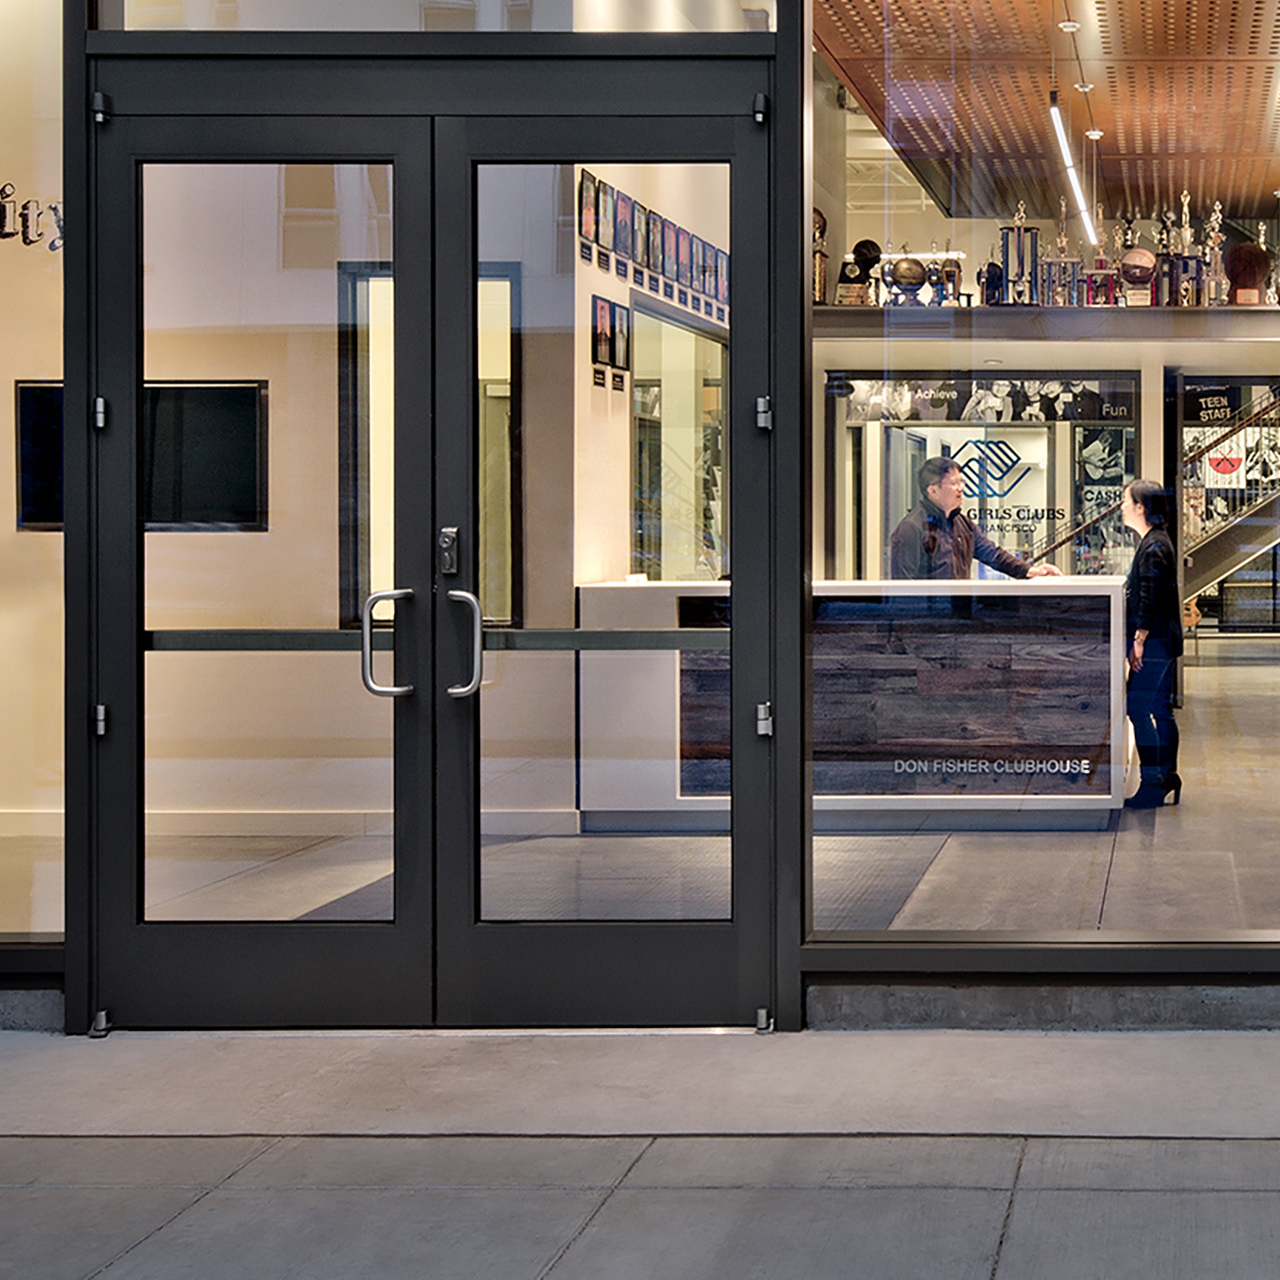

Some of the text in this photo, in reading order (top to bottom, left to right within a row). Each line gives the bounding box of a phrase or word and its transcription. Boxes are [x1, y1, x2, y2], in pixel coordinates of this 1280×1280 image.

[915, 388, 958, 400] Achieve
[1199, 396, 1229, 409] TEEN
[1102, 403, 1128, 417] Fun
[1199, 407, 1231, 422] STAFF
[1083, 489, 1122, 502] CASH
[967, 508, 1065, 520] GIRLS CLUBS
[894, 760, 1090, 773] DON FISHER CLUBHOUSE
